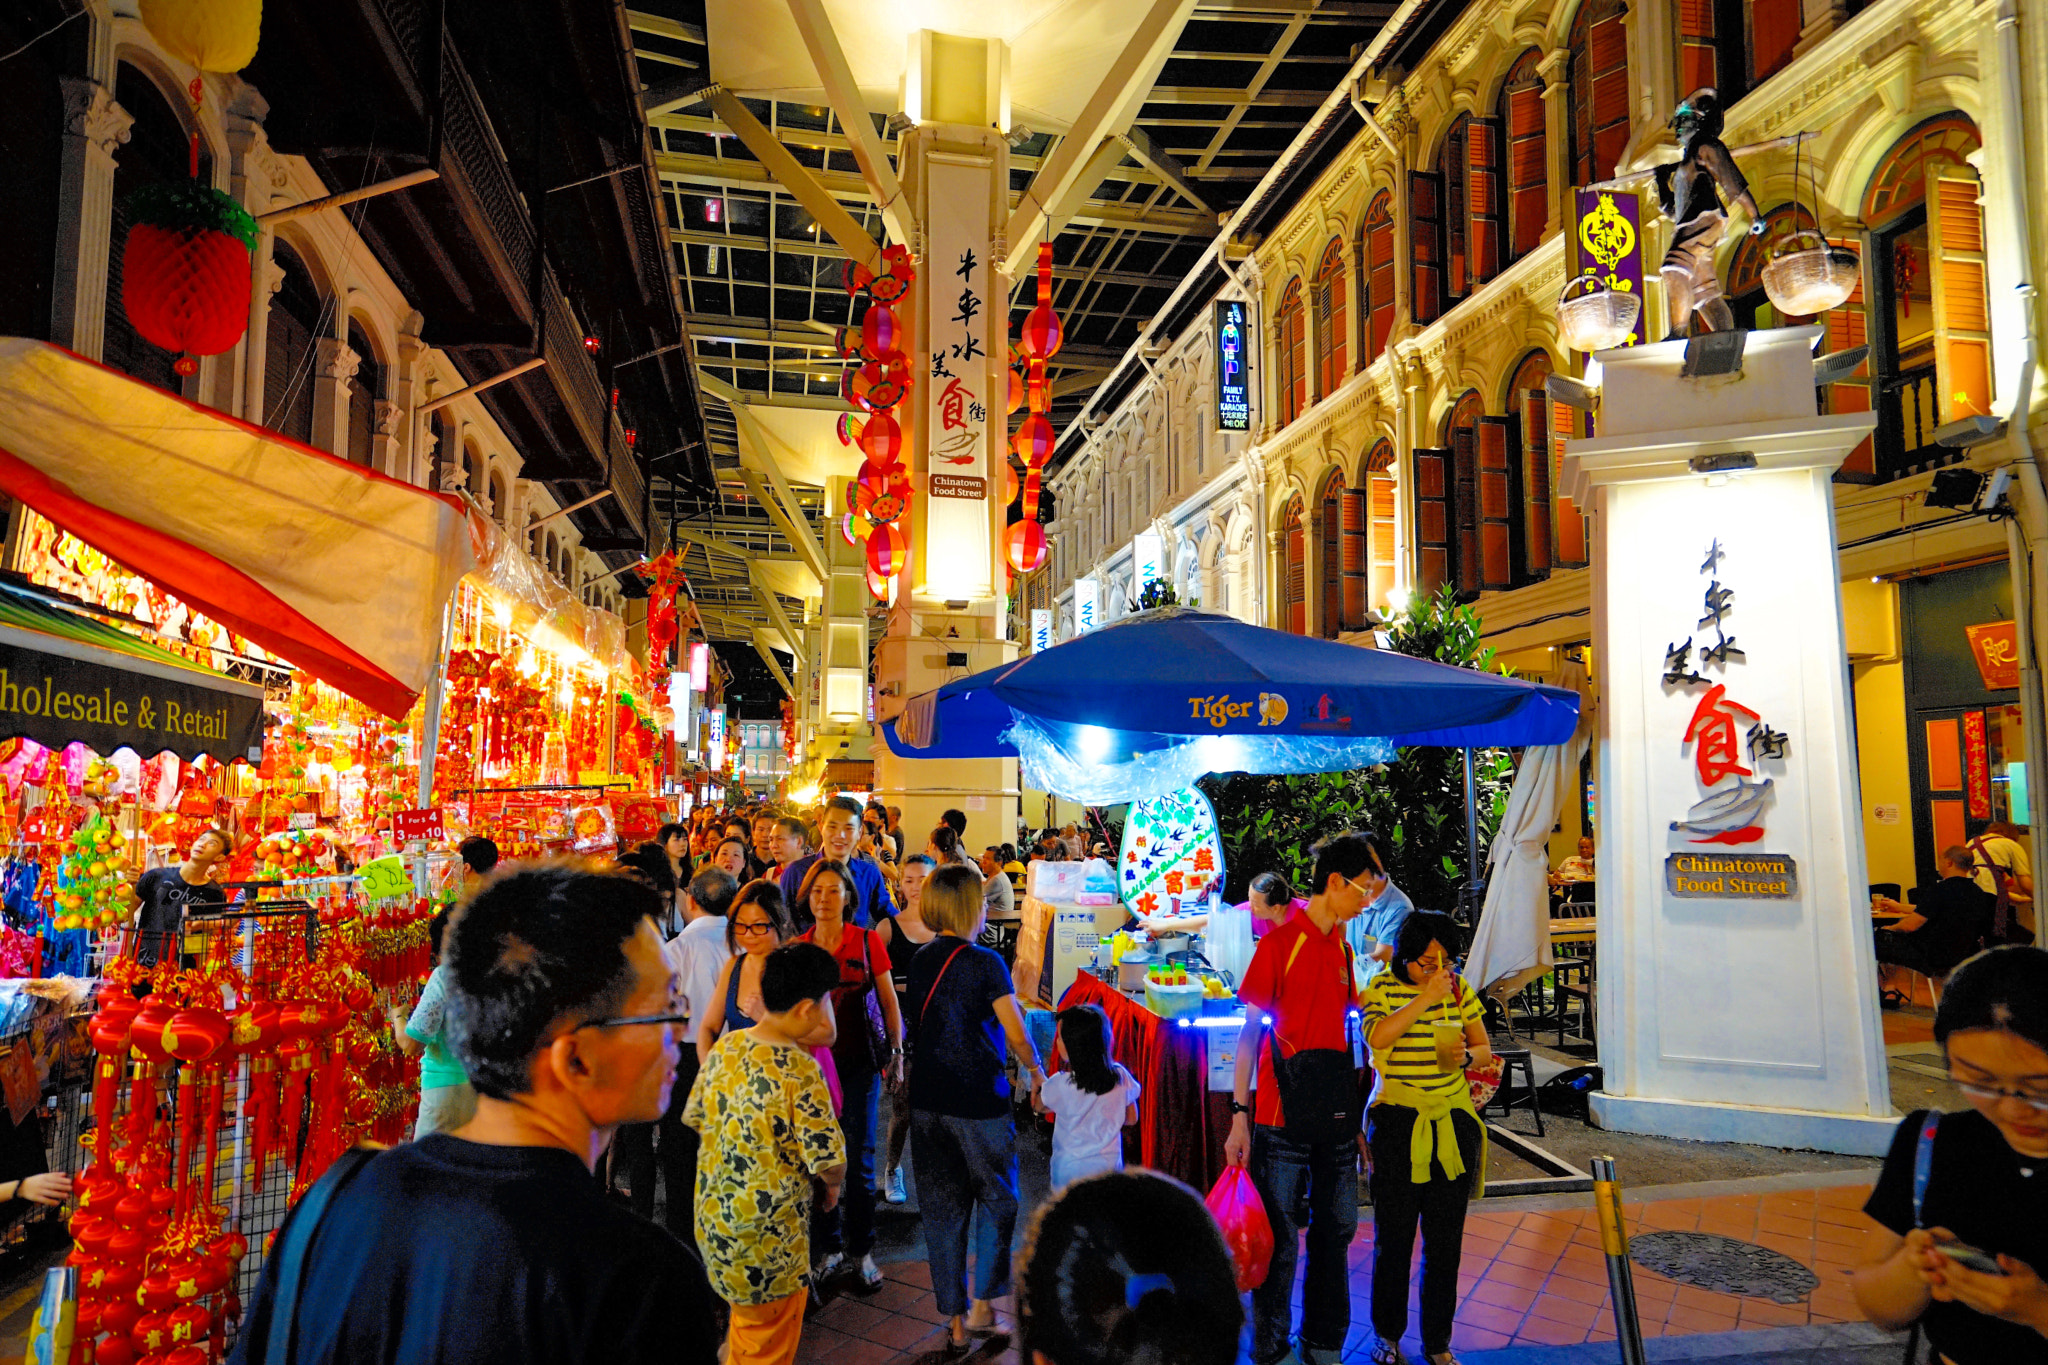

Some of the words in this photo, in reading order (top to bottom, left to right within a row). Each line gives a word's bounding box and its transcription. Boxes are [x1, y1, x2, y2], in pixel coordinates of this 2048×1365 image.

[931, 350, 986, 430] 美食街
[1223, 386, 1243, 395] FAMILY
[1220, 402, 1248, 412] KARAOKE
[934, 476, 982, 488] Chinatown
[934, 487, 955, 496] Food
[957, 488, 983, 497] Street
[137, 696, 156, 731] &
[165, 700, 228, 741] Retail
[1188, 694, 1254, 728] Tiger
[396, 813, 403, 825] 1
[421, 816, 426, 824] $
[429, 811, 437, 822] 4
[397, 829, 405, 841] 3
[1676, 856, 1786, 874] Chinatown
[163, 880, 207, 905] alvi
[1676, 877, 1724, 893] Food
[1729, 877, 1788, 895] Street
